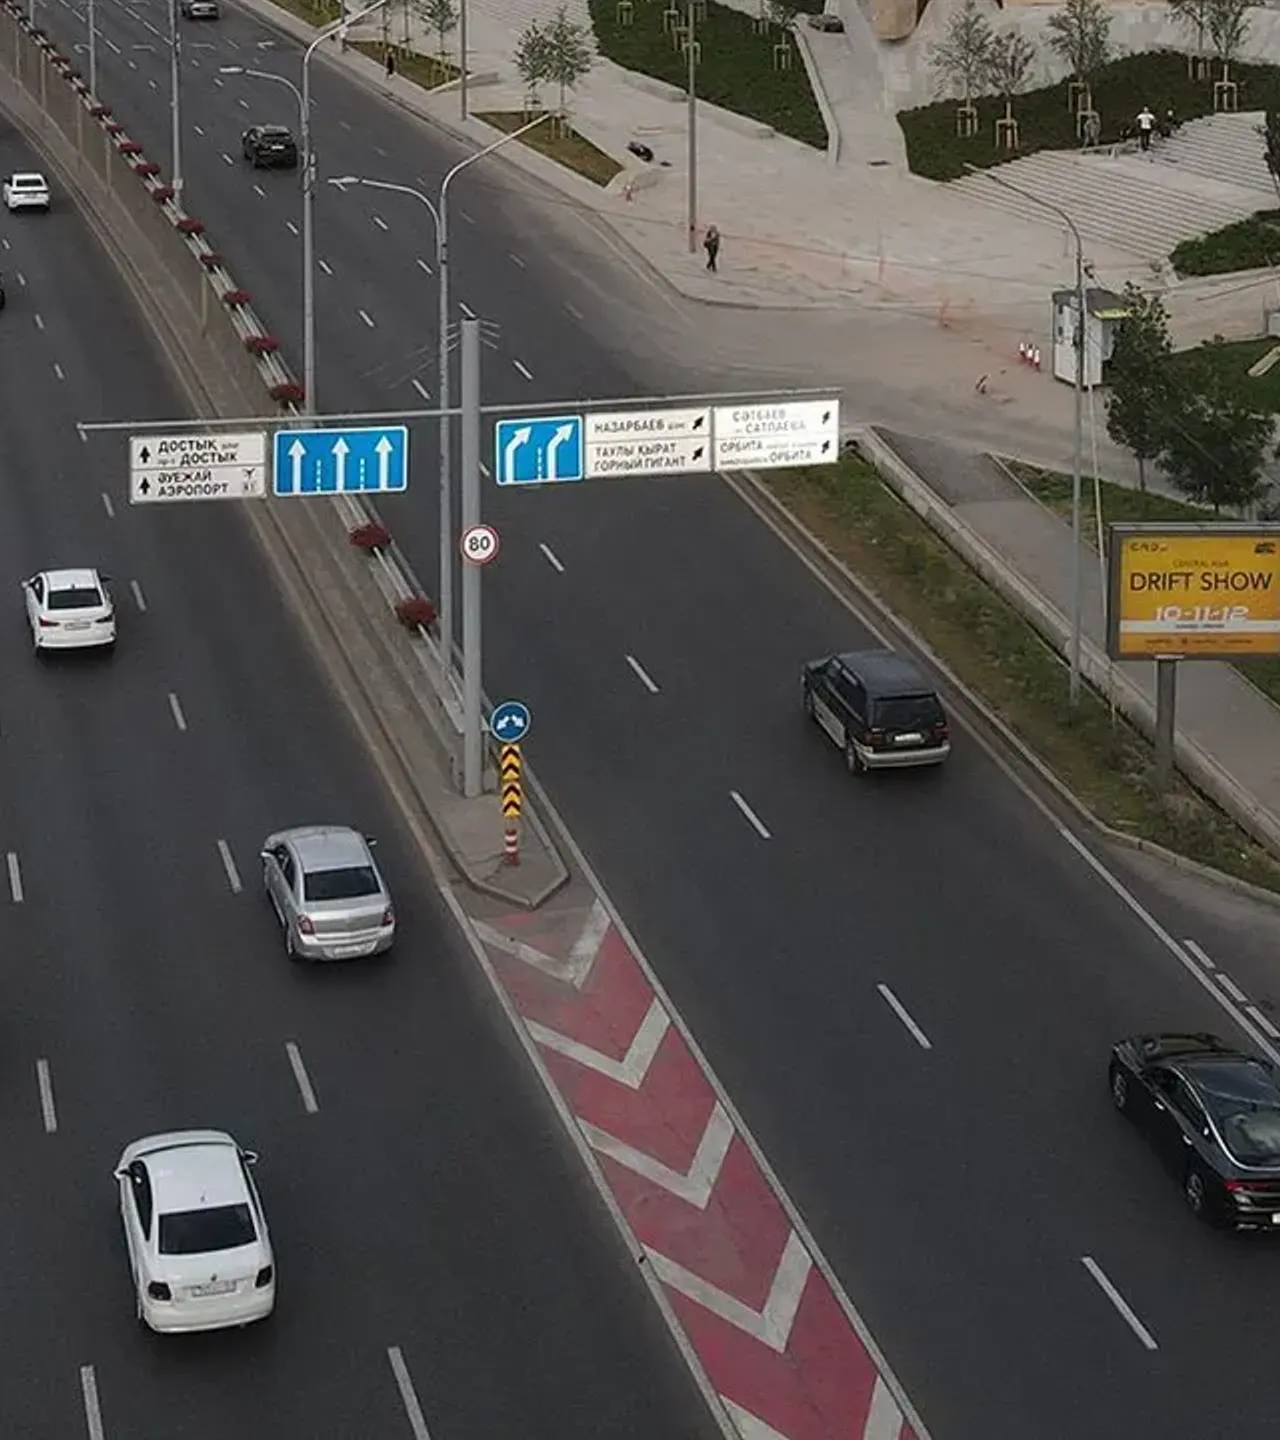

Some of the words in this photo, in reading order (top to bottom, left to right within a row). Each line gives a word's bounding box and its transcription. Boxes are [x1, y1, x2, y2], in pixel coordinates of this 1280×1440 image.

[180, 451, 237, 466] ДОСТЫК
[158, 482, 229, 497] АЭРОПОРТ
[469, 535, 491, 552] 80
[1129, 571, 1195, 592] DRIFT
[1199, 571, 1273, 592] SHOW
